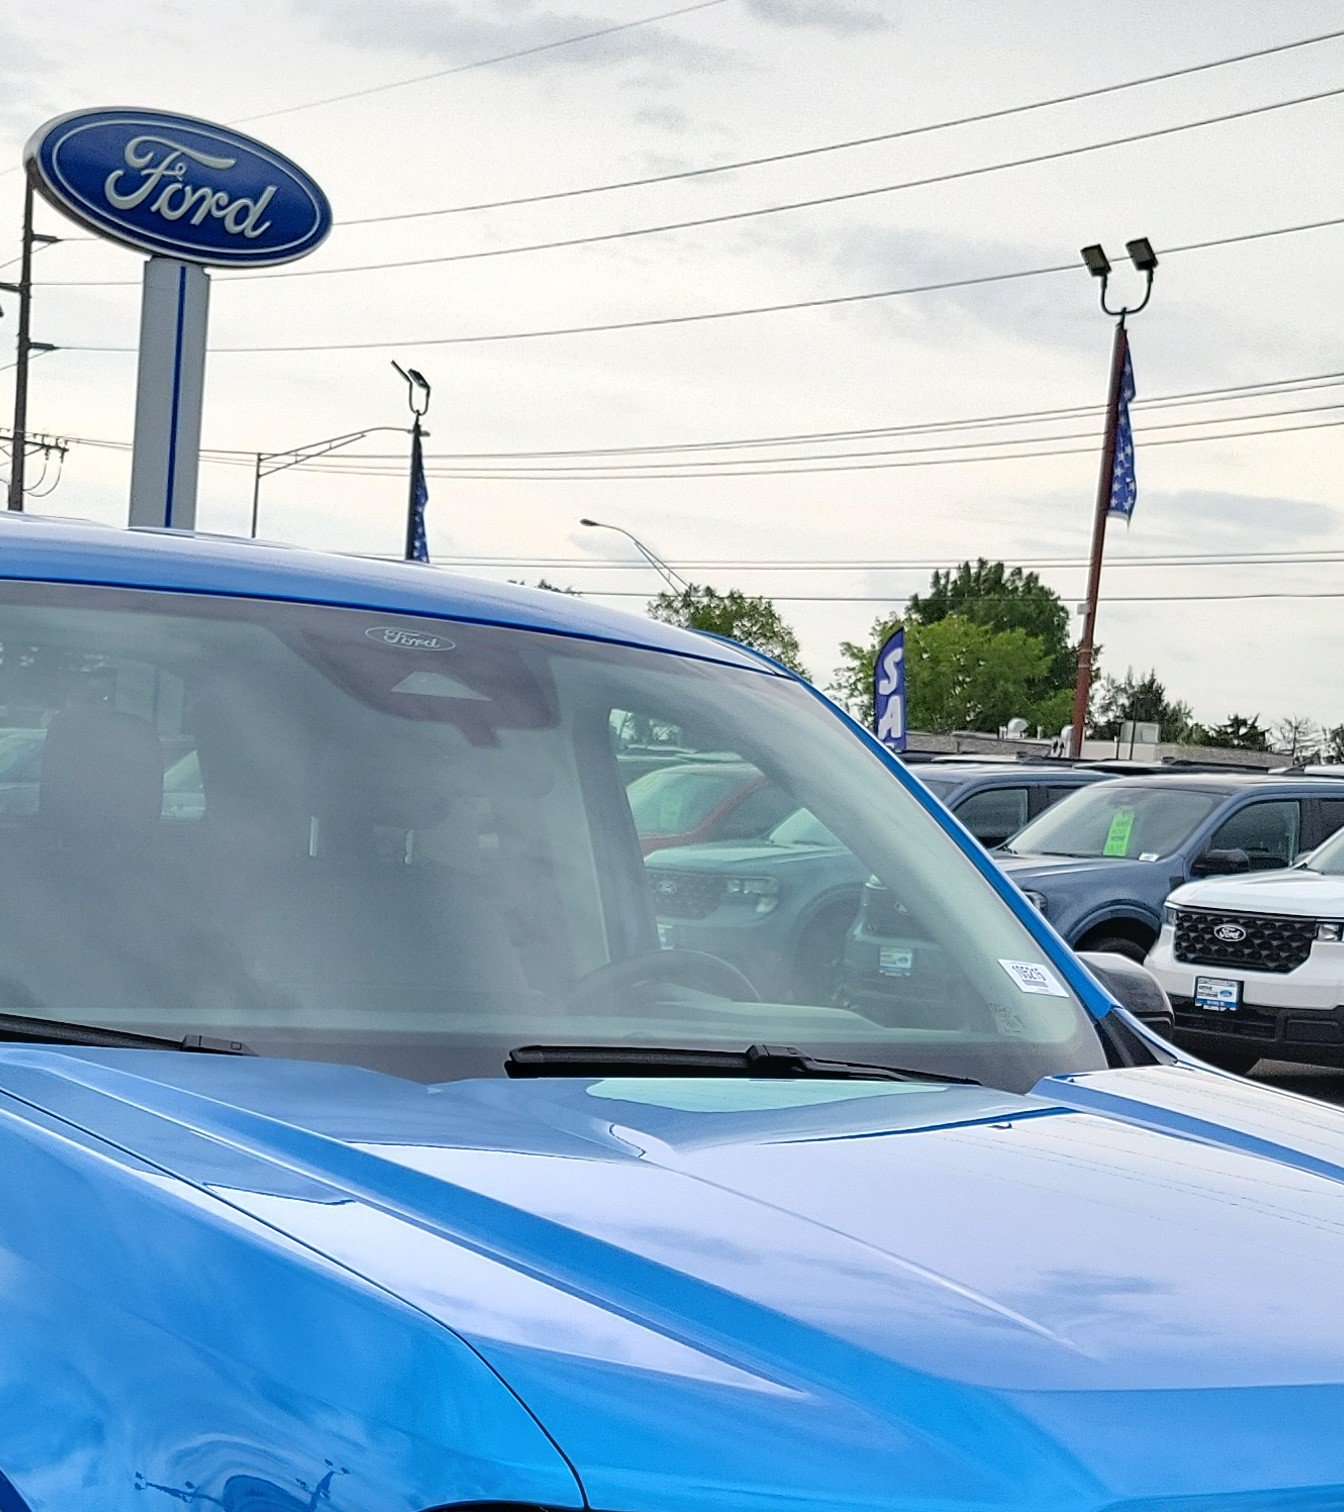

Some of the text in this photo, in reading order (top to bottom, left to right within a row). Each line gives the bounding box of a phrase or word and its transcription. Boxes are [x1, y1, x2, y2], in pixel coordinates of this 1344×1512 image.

[104, 135, 277, 239] Ford
[383, 629, 440, 649] Ford
[877, 647, 904, 752] SA
